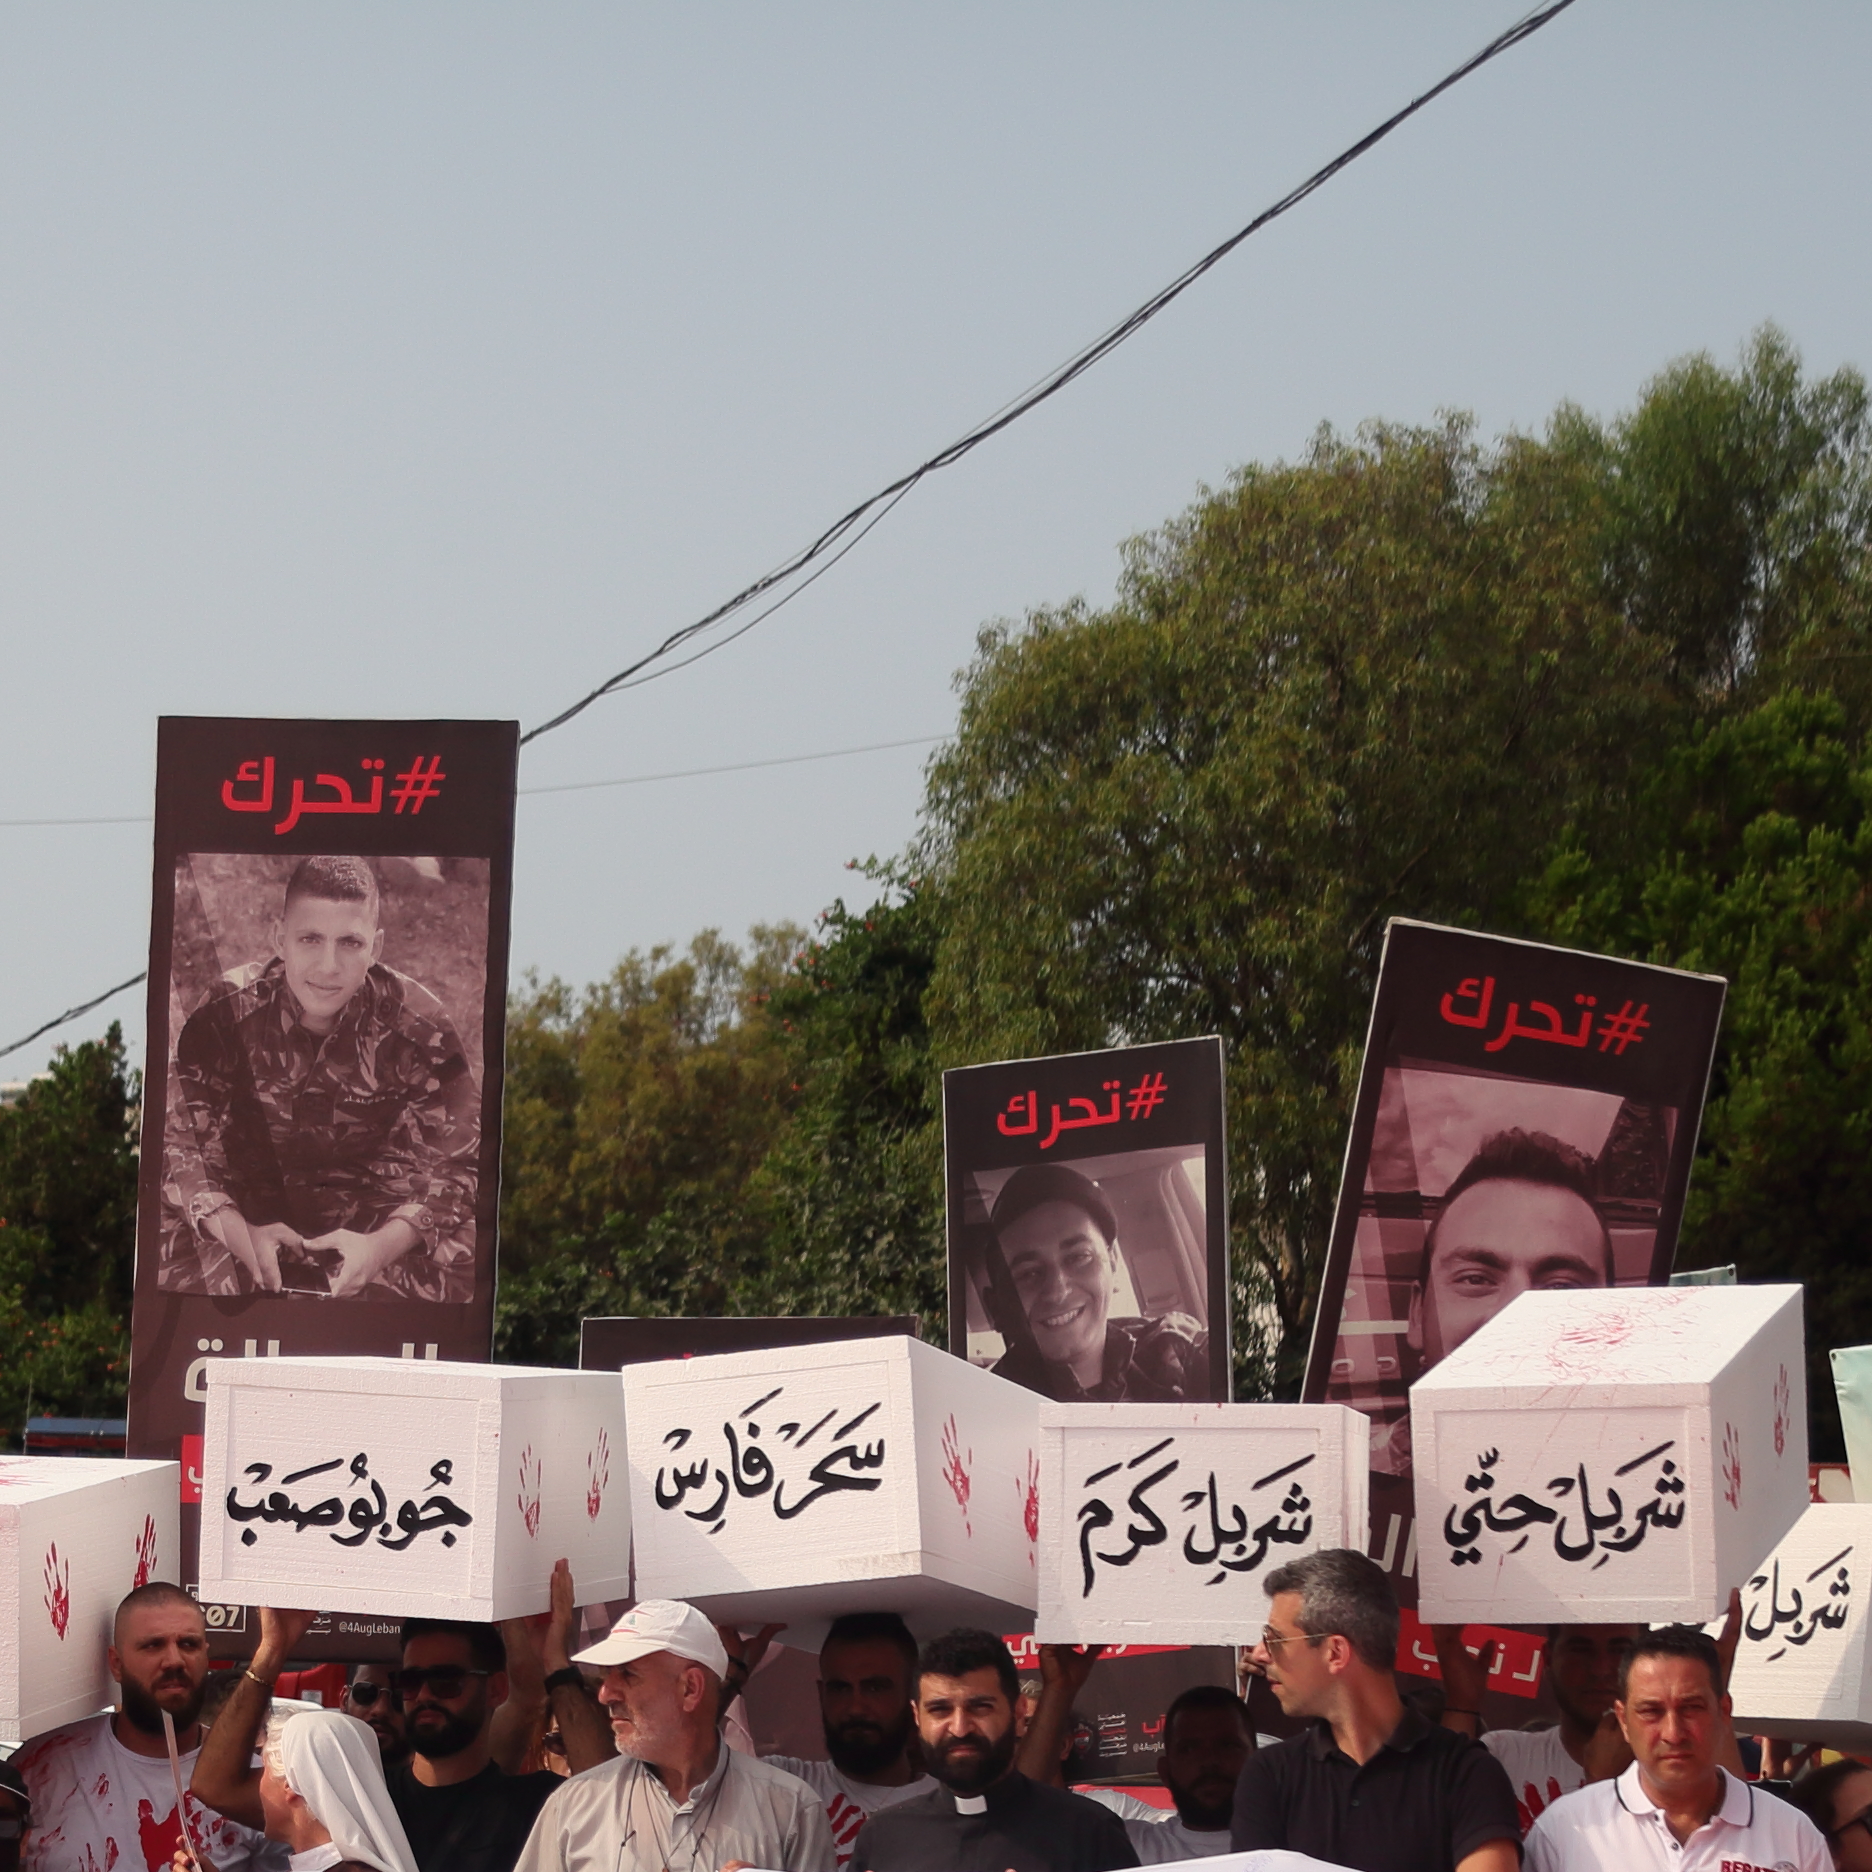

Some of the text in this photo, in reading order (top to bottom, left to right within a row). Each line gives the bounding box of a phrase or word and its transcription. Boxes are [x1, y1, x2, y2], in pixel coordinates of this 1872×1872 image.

[221, 755, 446, 836] #تحرك
[1439, 976, 1651, 1055] #تحرك
[996, 1072, 1168, 1150] #تحرك
